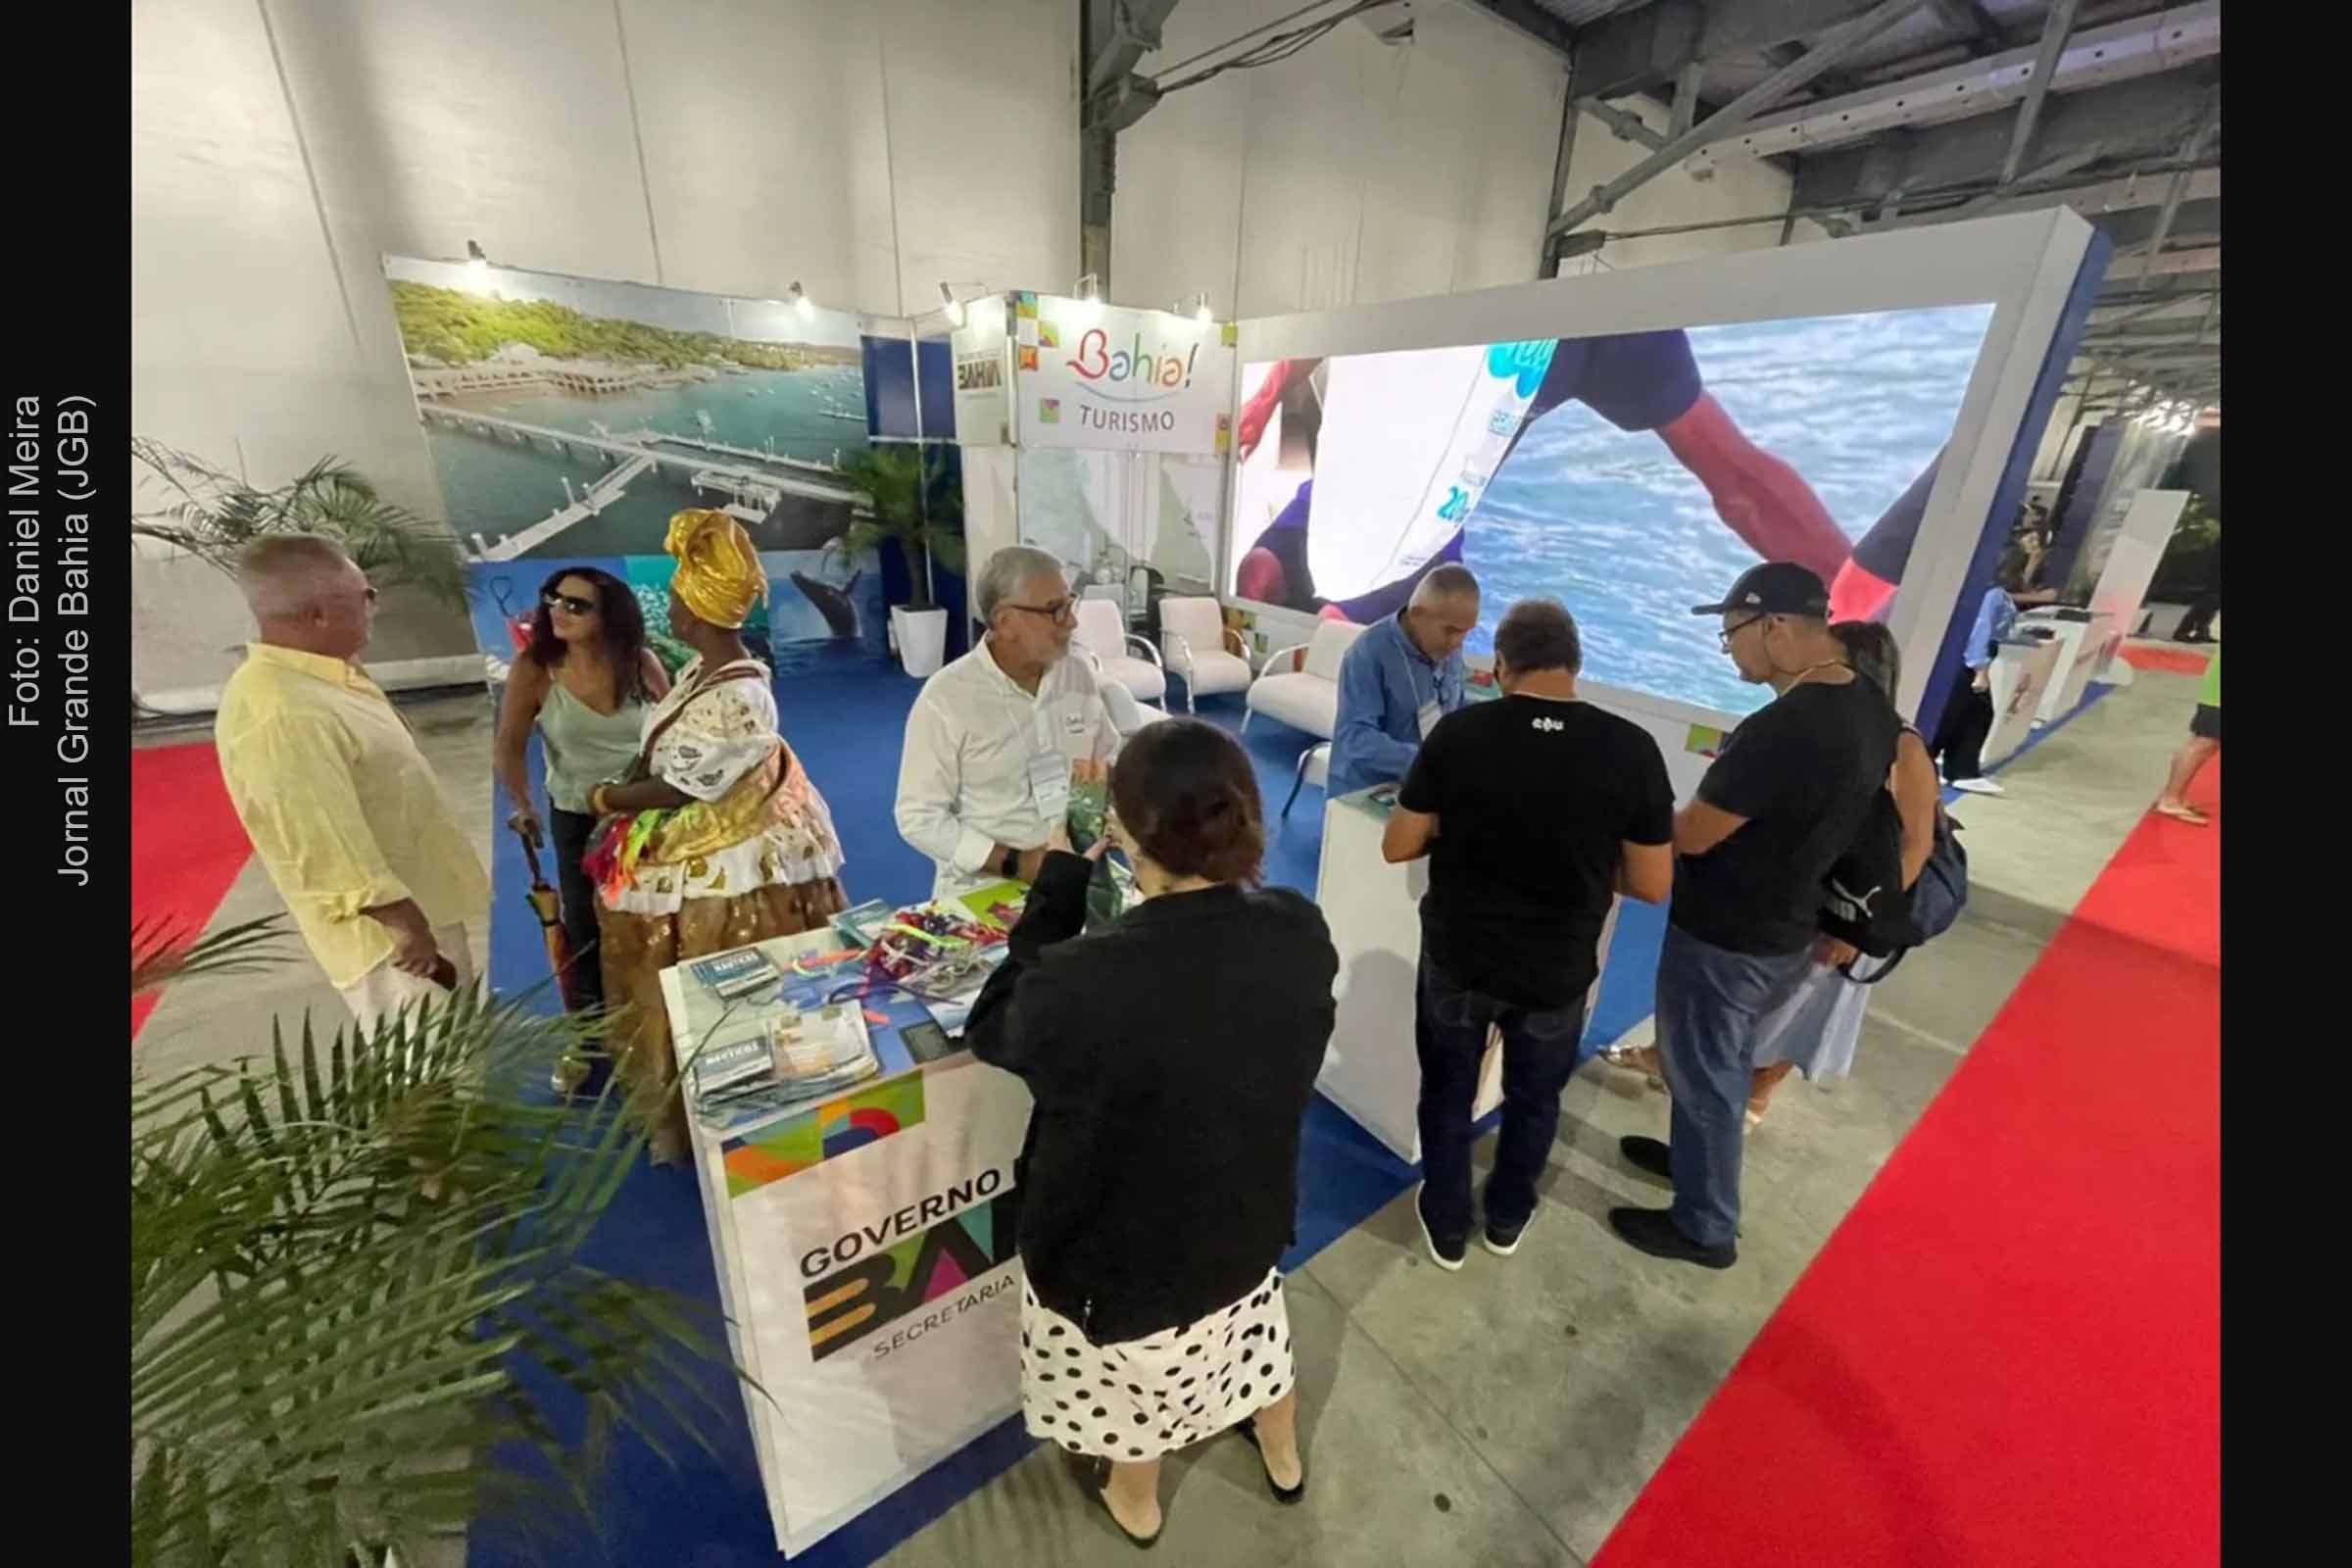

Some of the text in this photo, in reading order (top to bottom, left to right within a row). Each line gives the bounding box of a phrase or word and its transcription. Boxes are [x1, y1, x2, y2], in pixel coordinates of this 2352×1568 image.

[1065, 328, 1200, 388] Bahia!
[1079, 404, 1175, 433] TURISMO
[800, 1168, 1001, 1278] GOVERNO
[873, 1274, 1016, 1360] SECRETARIA
